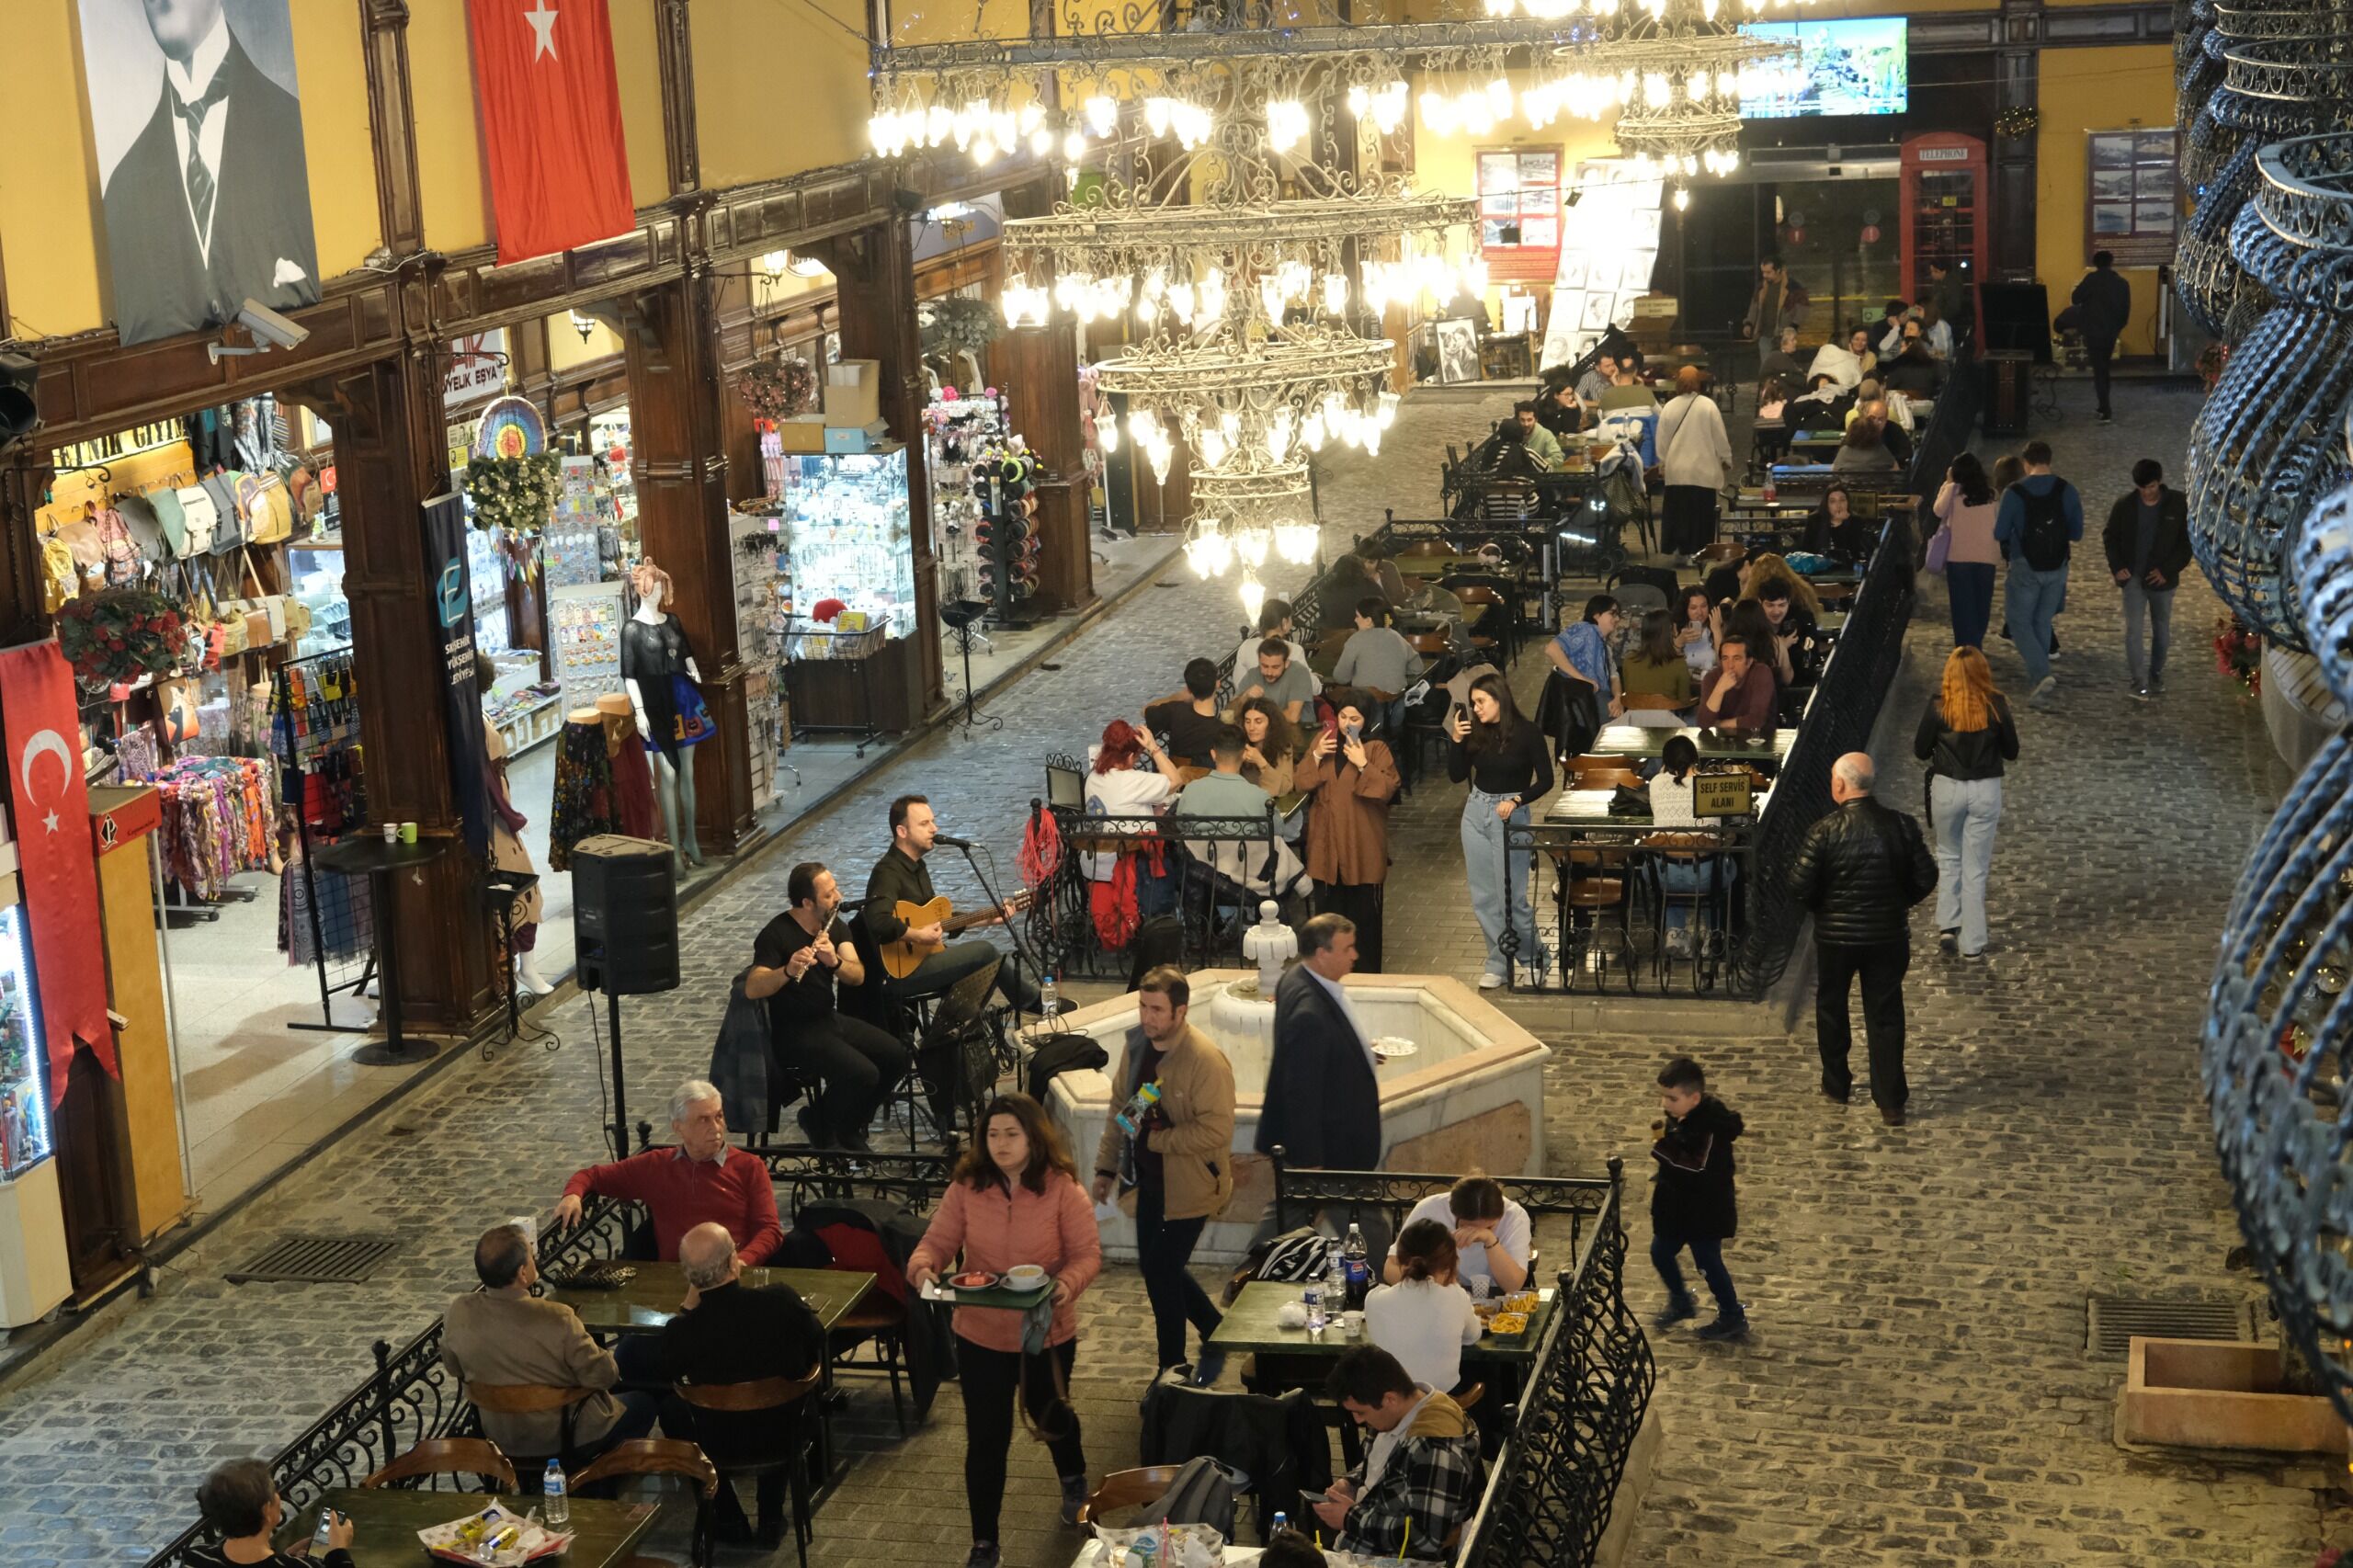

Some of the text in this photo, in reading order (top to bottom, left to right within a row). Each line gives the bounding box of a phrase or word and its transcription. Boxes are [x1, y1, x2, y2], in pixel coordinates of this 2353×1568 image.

[1920, 148, 1964, 159] TELEPHONE
[1700, 778, 1745, 794] SELF SERVİS
[1711, 797, 1734, 808] ALANI
